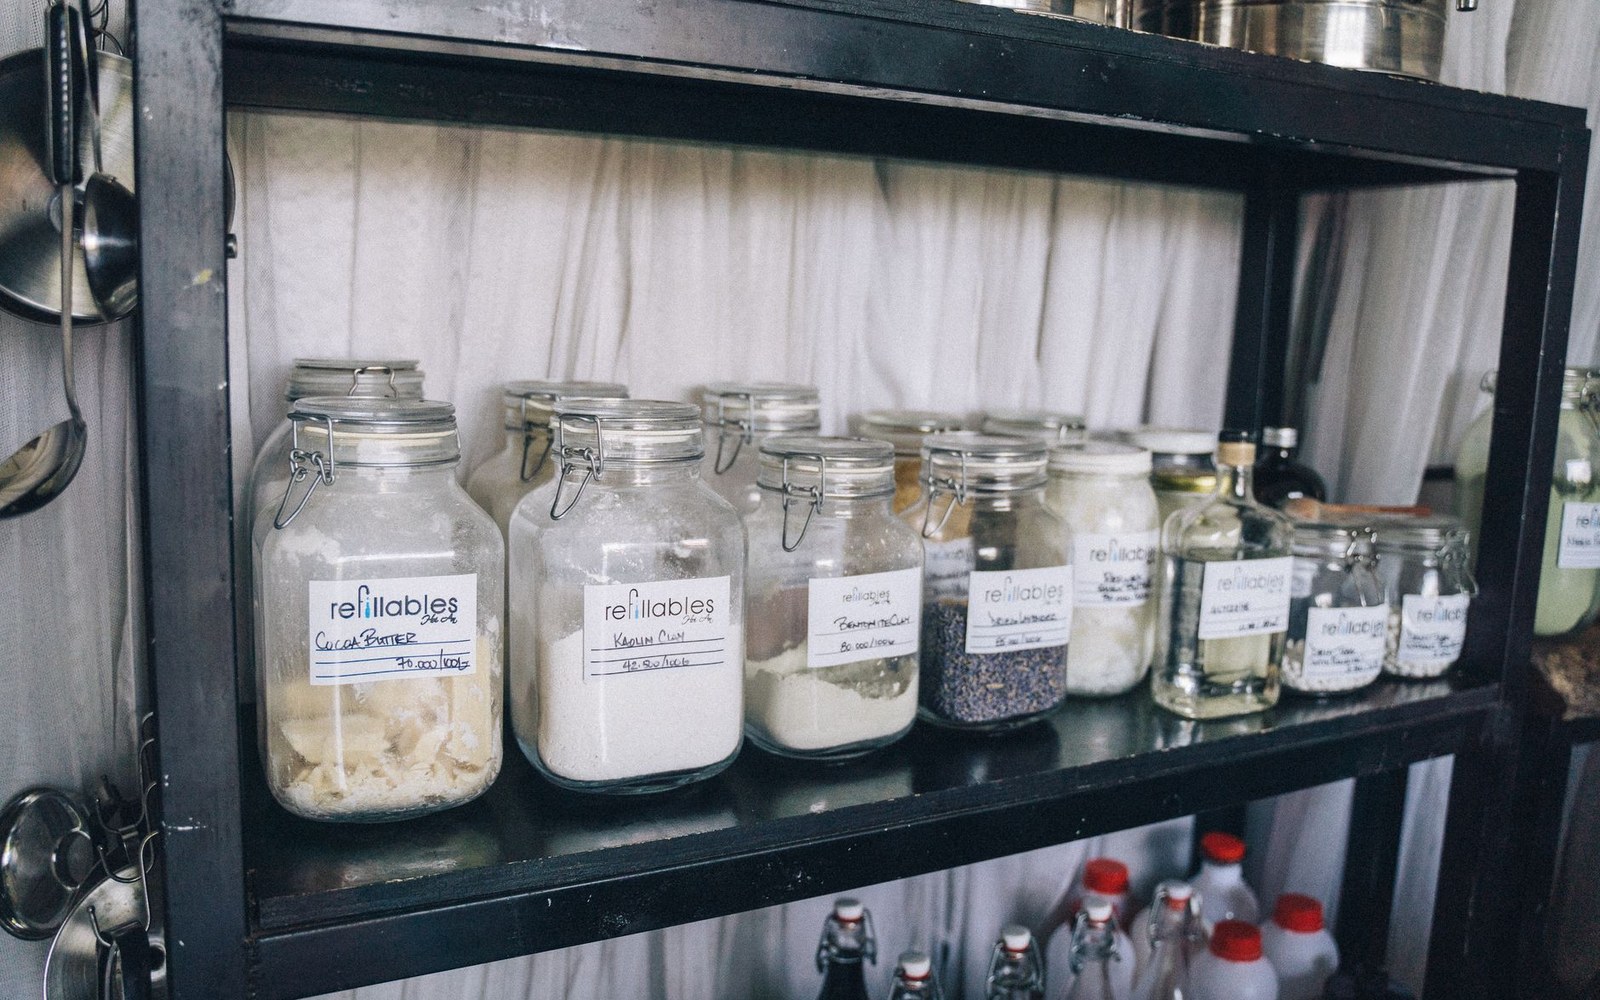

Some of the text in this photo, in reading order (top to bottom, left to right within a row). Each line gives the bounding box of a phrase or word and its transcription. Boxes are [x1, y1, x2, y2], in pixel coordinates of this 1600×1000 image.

[985, 575, 1064, 603] refillables
[1217, 566, 1284, 591] refillables
[331, 585, 458, 619] refillables
[605, 588, 715, 621] refillables
[842, 586, 890, 603] refillables
[360, 628, 418, 647] BUTTER
[613, 632, 654, 648] KAOLIN
